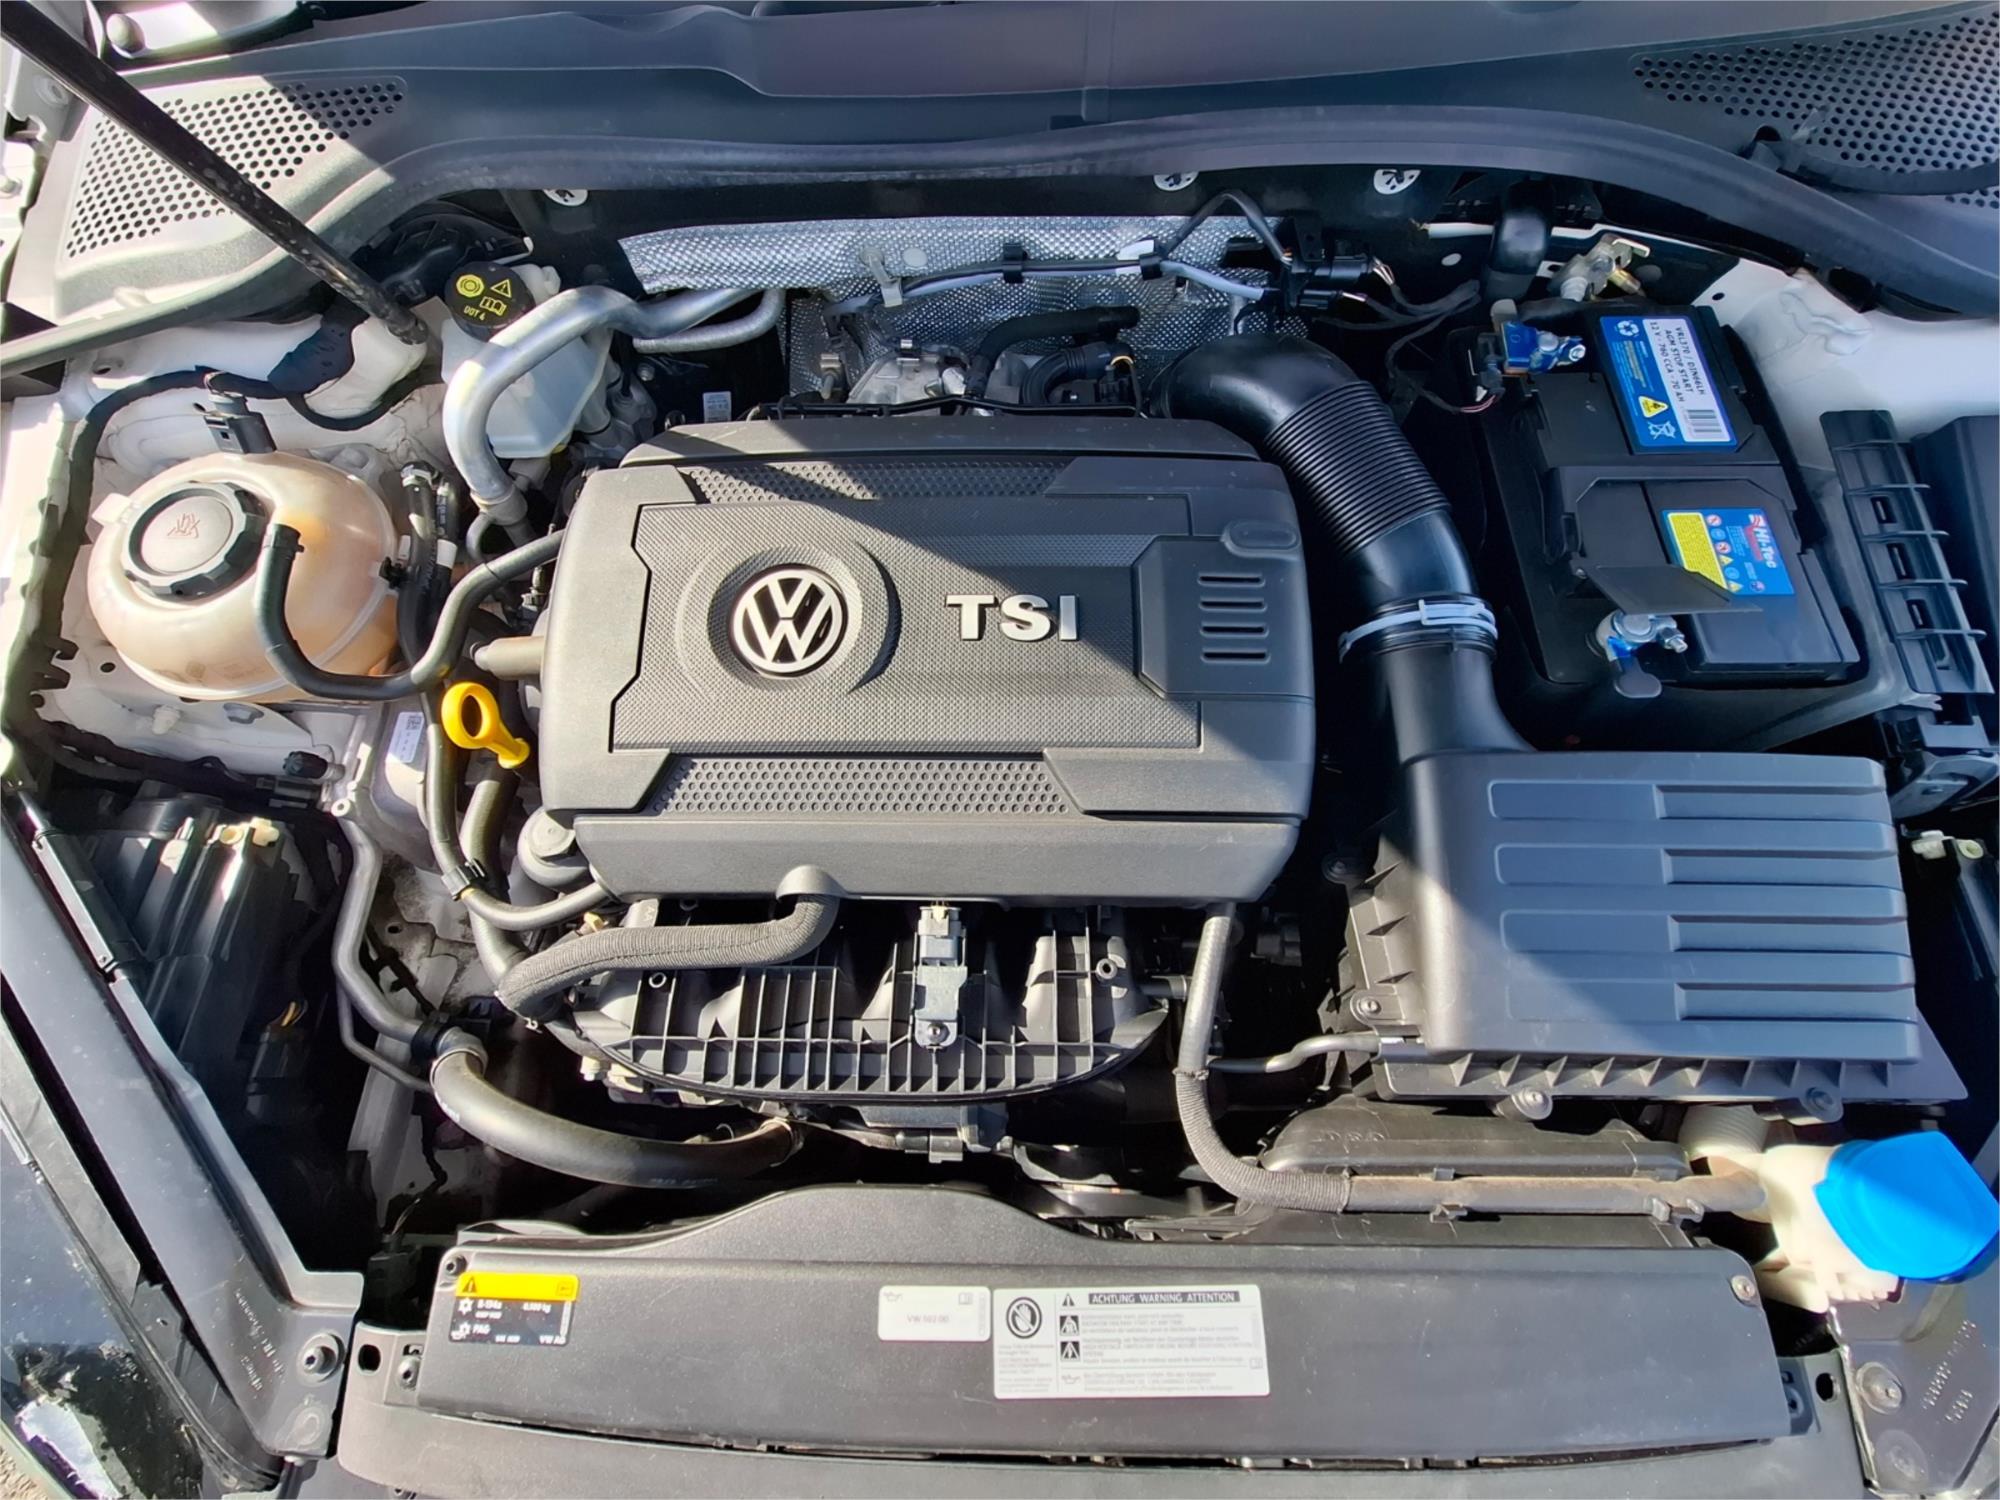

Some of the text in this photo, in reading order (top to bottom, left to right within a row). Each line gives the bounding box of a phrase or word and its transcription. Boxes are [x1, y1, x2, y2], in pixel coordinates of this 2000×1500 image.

[463, 305, 480, 318] DOT
[1663, 358, 1674, 373] CCA
[1670, 347, 1684, 367] STOP
[1678, 368, 1695, 392] START
[945, 594, 1079, 642] TSI
[1091, 1291, 1236, 1304] ACHTUNG WARNING ATTENTION
